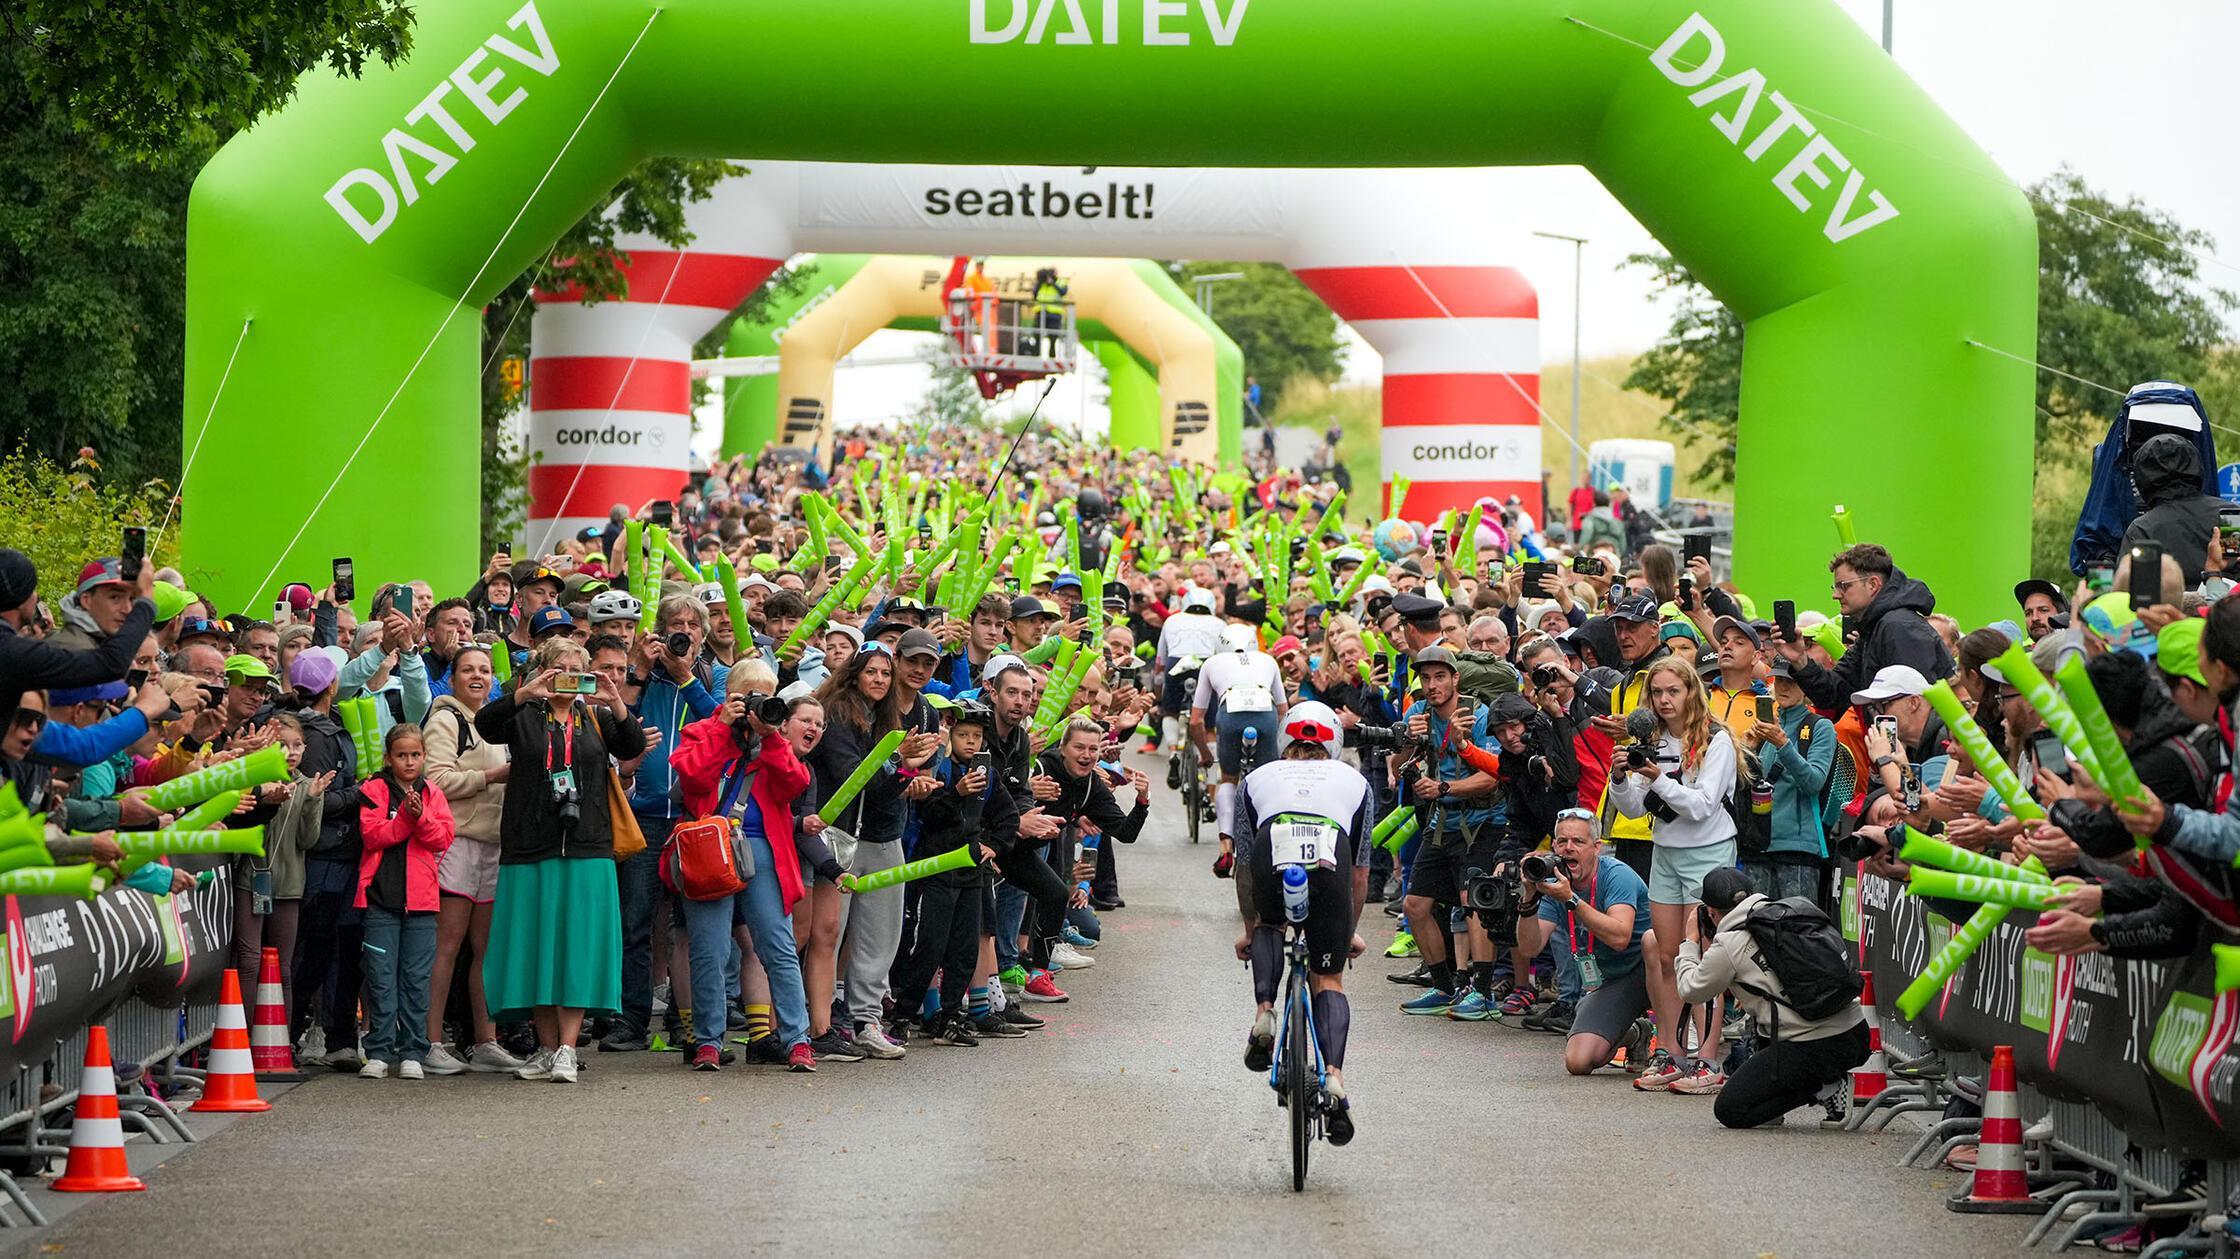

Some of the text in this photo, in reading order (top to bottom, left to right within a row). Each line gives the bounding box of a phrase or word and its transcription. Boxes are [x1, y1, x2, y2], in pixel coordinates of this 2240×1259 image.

[969, 0, 1249, 46] DATEV
[323, 0, 561, 244] DATEV
[1648, 11, 1900, 244] DATEV
[924, 183, 1155, 220] seatbelt!
[556, 425, 643, 446] condor
[1412, 440, 1499, 461] condor
[1955, 712, 2034, 807] DATEV
[1300, 843, 1315, 860] 13
